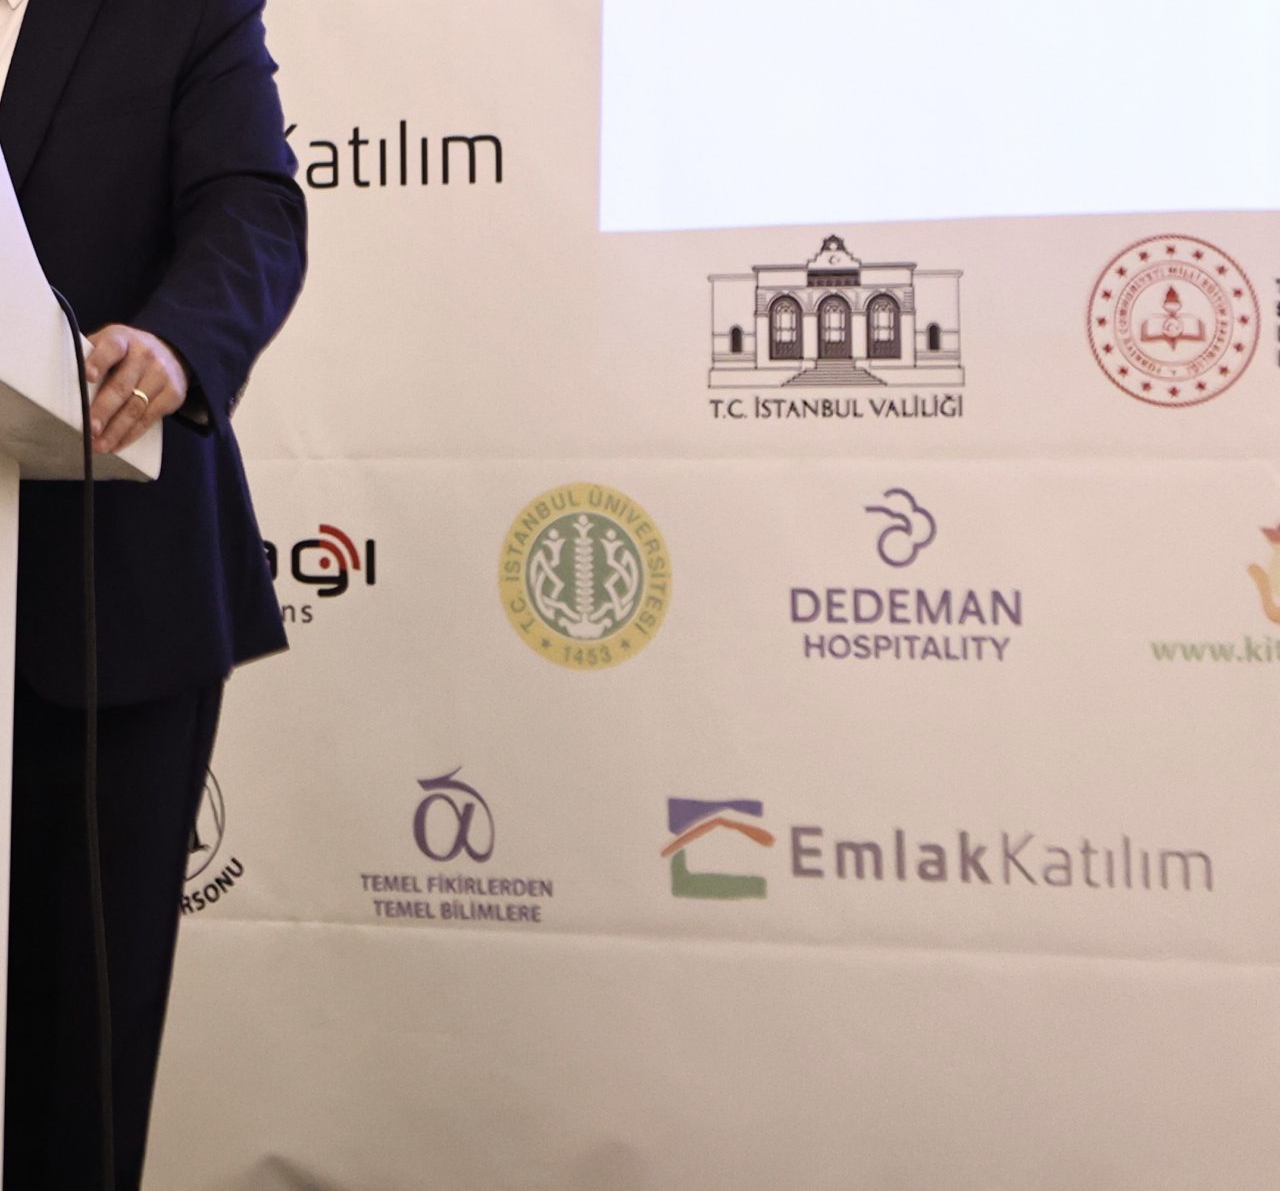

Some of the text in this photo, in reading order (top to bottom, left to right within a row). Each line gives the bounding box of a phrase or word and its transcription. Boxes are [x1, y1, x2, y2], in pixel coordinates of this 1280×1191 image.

[285, 119, 503, 189] atılım
[754, 395, 864, 420] İSTANBUL
[869, 393, 965, 419] VALİLİĞİ
[790, 587, 1022, 627] DEDEMAN
[803, 633, 1012, 662] HOSPITALITY
[181, 857, 245, 916] RSONU
[360, 872, 554, 898] TEMEL FİKİRLERDEN
[373, 898, 542, 924] TEMEL BİLİMLERE
